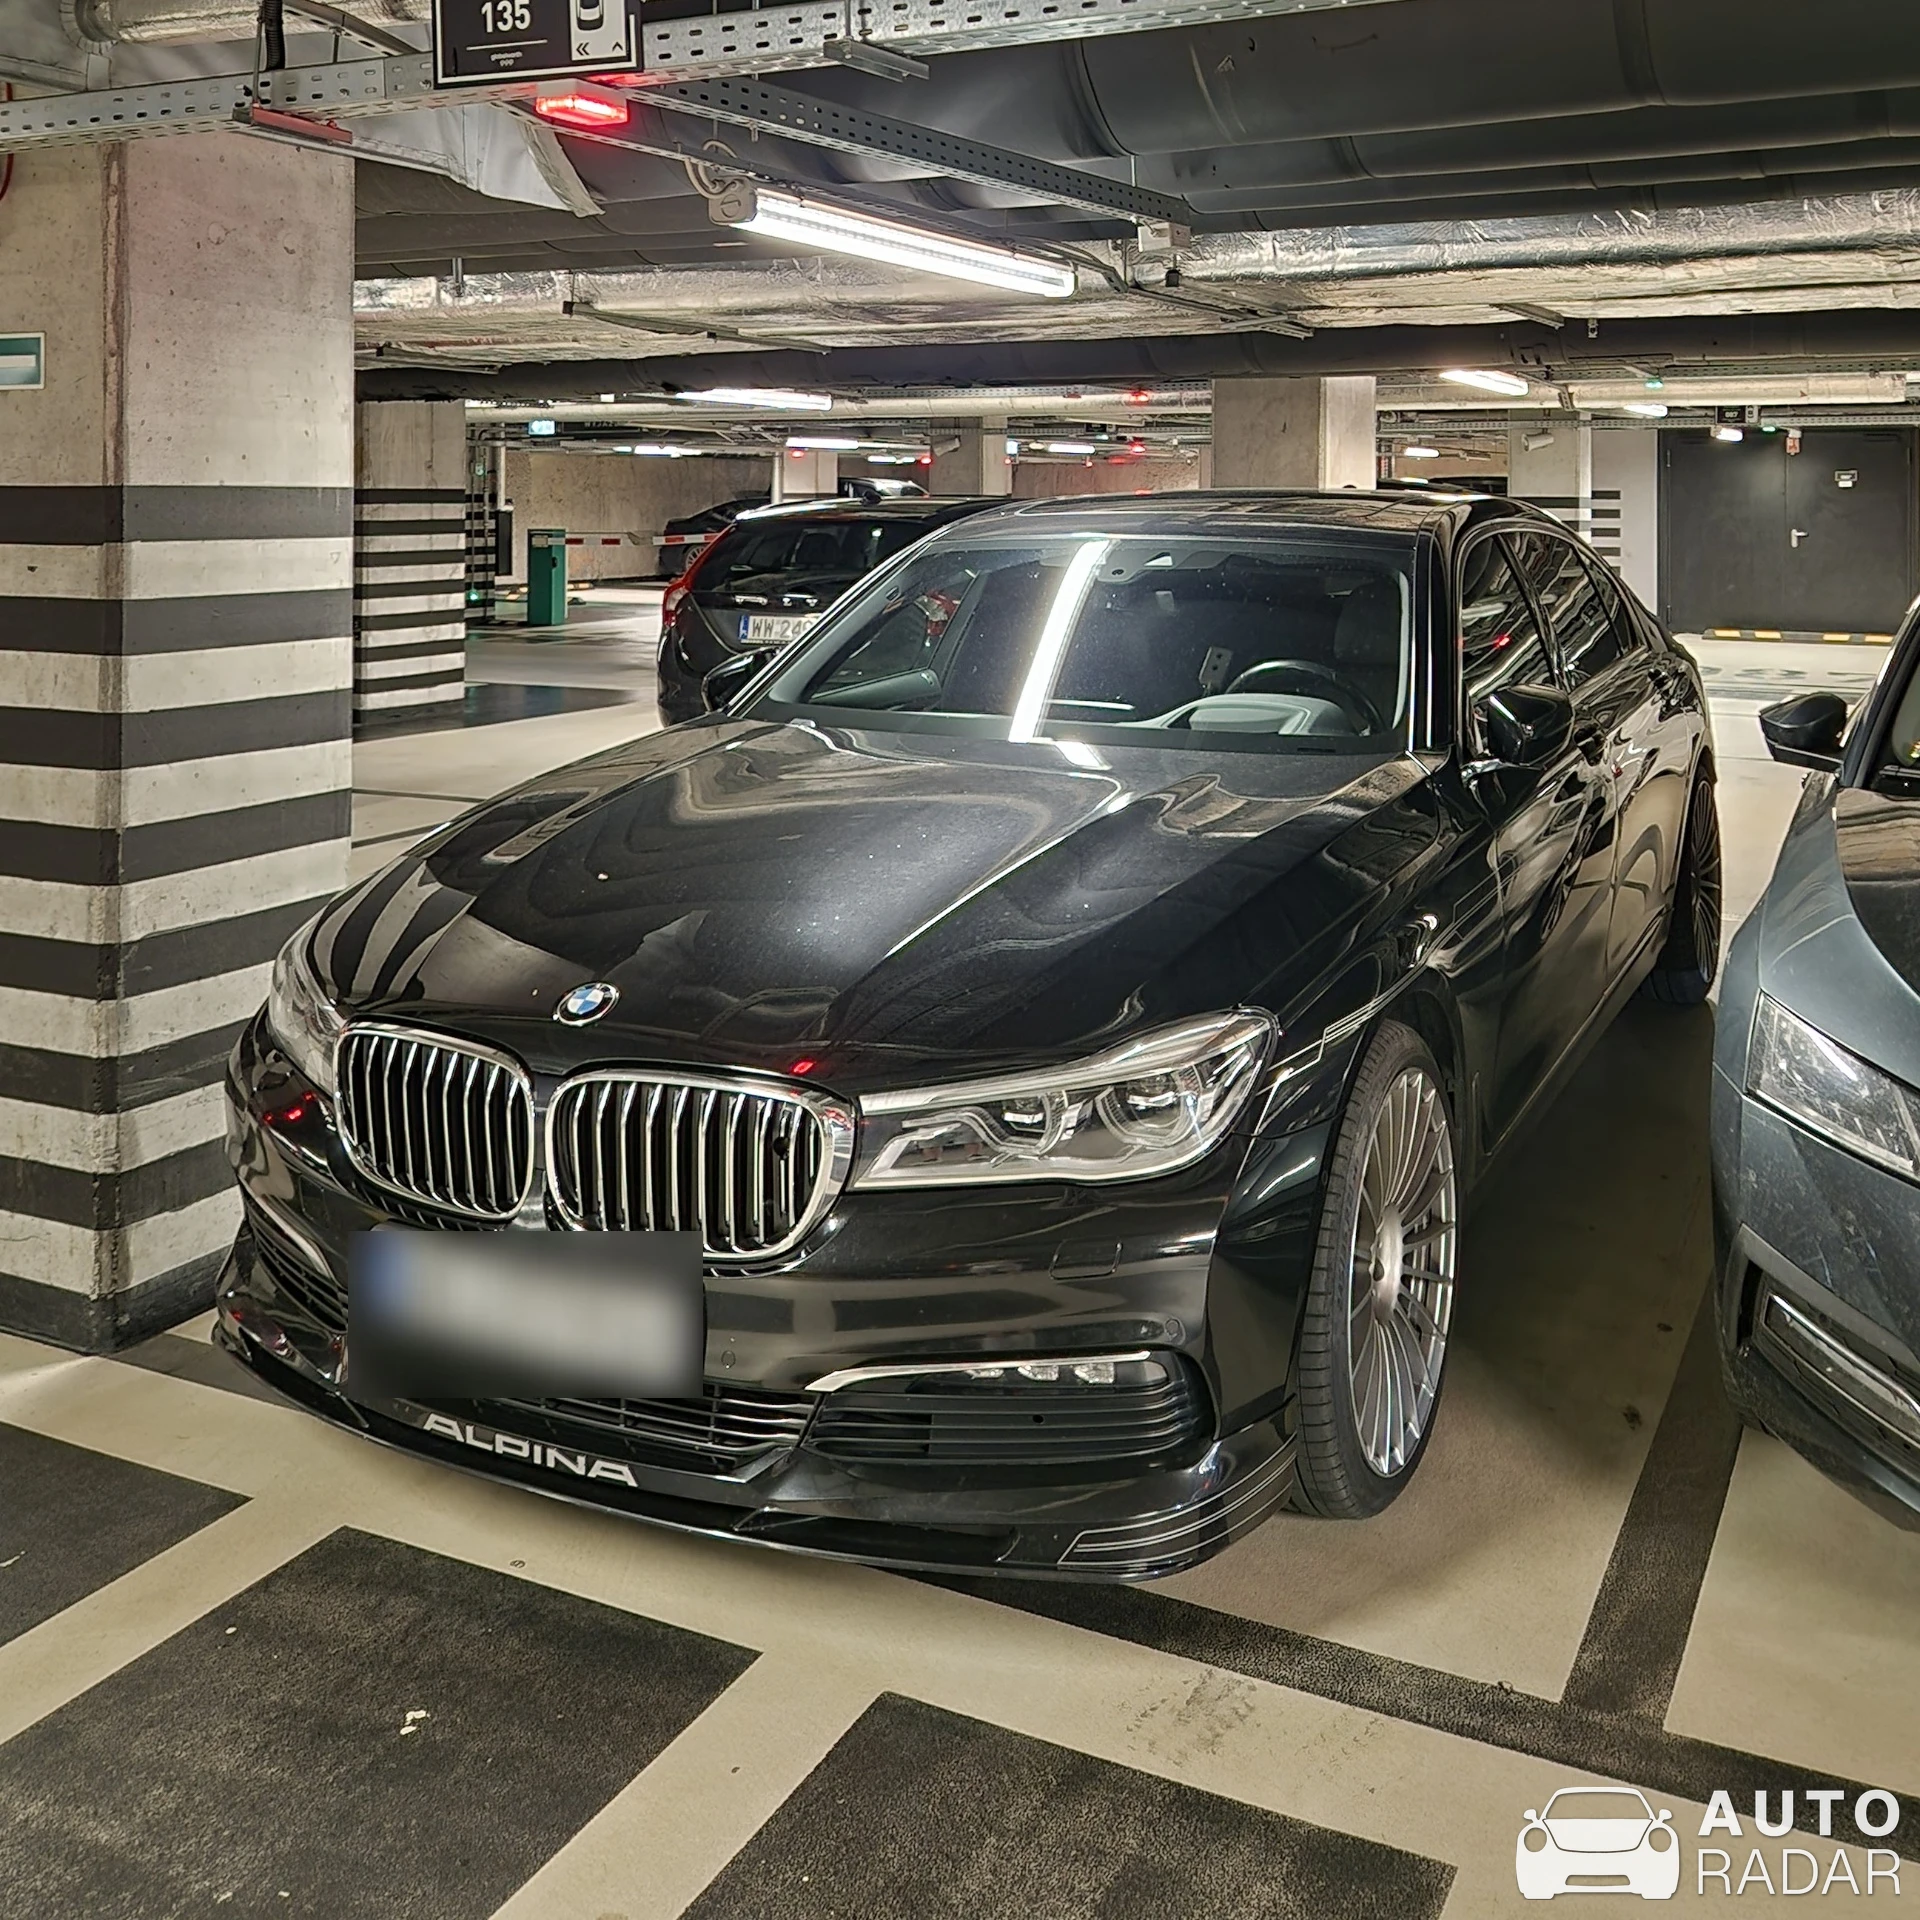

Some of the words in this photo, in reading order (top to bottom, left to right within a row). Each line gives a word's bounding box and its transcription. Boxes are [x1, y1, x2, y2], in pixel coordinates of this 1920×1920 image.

[481, 0, 531, 33] 135
[752, 618, 774, 638] WW
[423, 1413, 638, 1487] ALPINA
